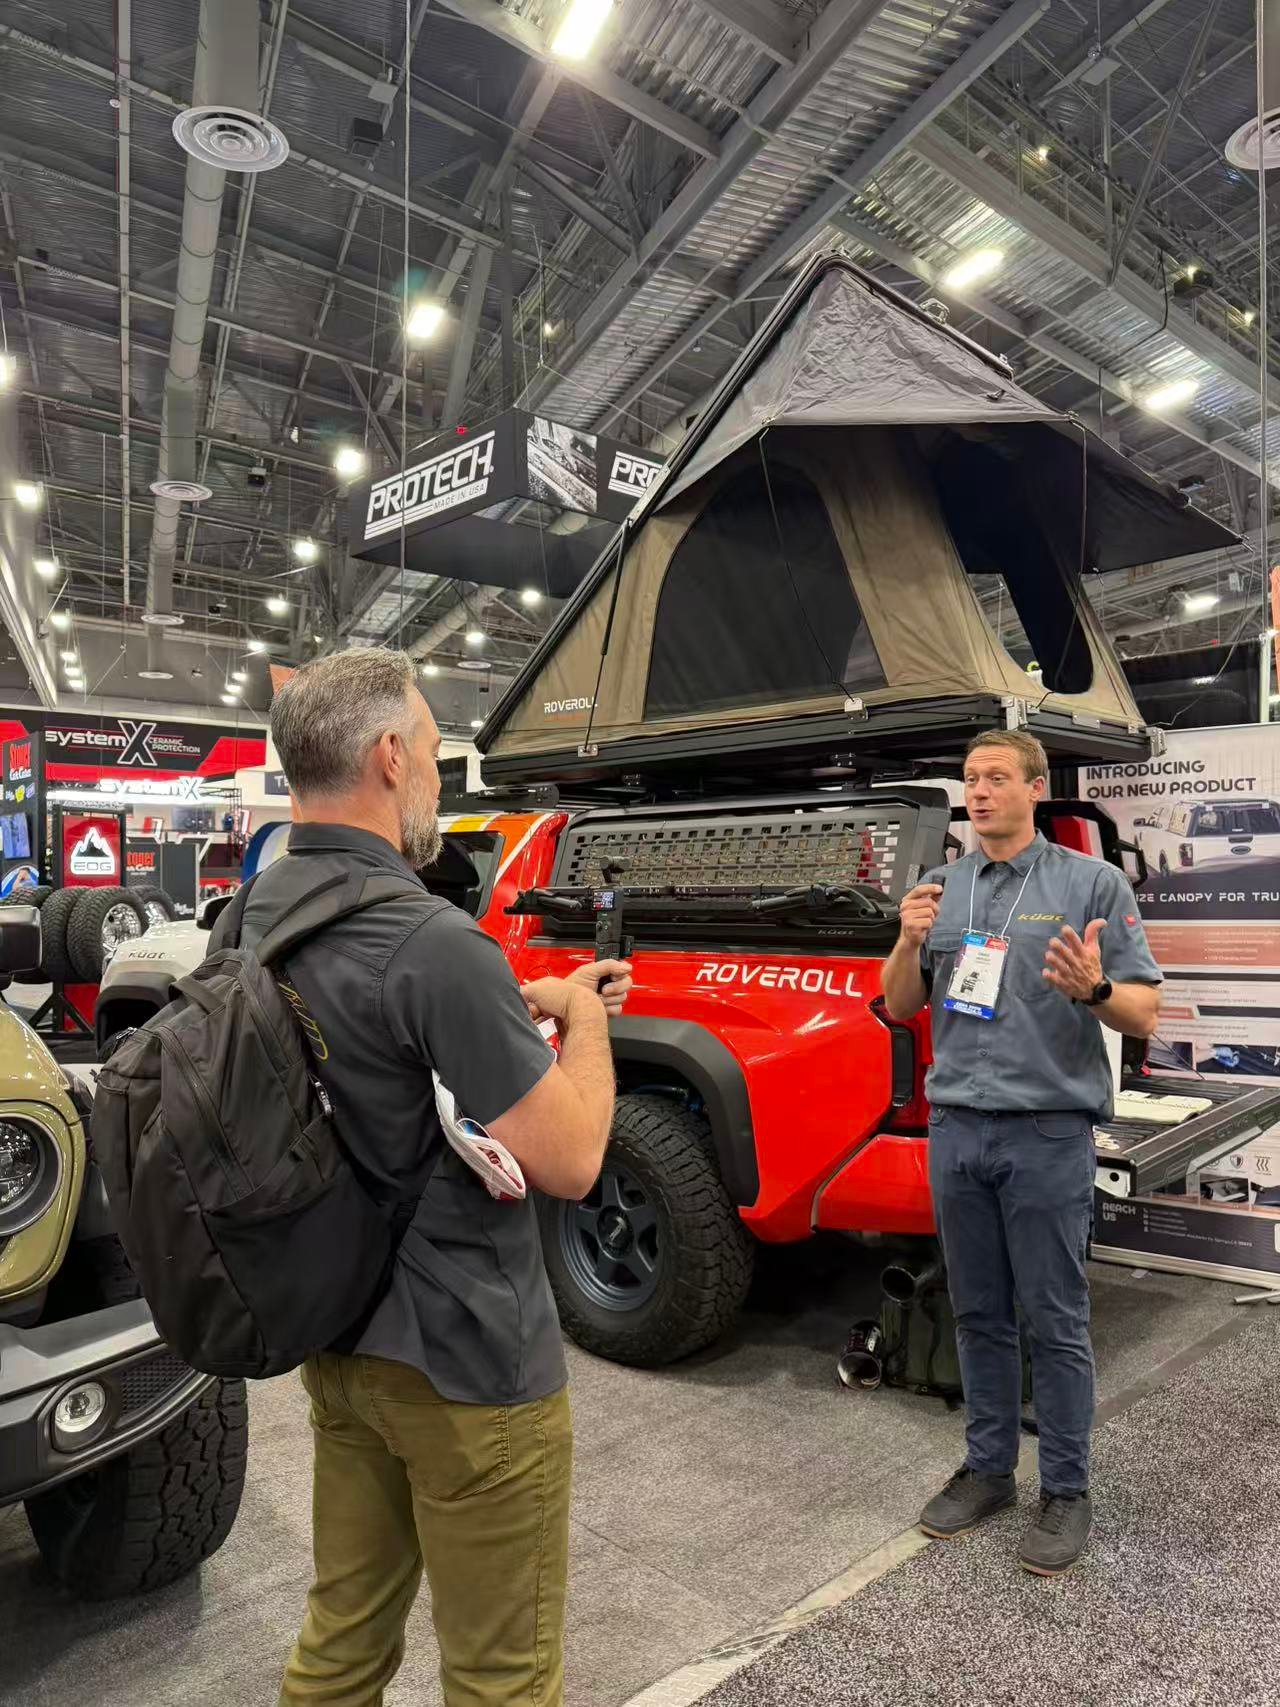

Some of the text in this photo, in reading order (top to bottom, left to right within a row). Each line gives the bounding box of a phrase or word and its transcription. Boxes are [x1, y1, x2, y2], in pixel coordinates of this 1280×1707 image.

[433, 483, 485, 511] MADE IN USA
[148, 736, 183, 746] CERAMIC
[151, 744, 200, 753] PROTECTION
[1086, 760, 1205, 780] INTRODUCING
[1087, 777, 1257, 799] OUR NEW PRODUCT
[1159, 892, 1213, 902] CANOPY
[1219, 892, 1246, 902] FOR
[1252, 891, 1280, 902] TRU
[696, 962, 862, 998] ROVEROLL
[1102, 1201, 1136, 1216] REACH
[1103, 1213, 1117, 1222] US
